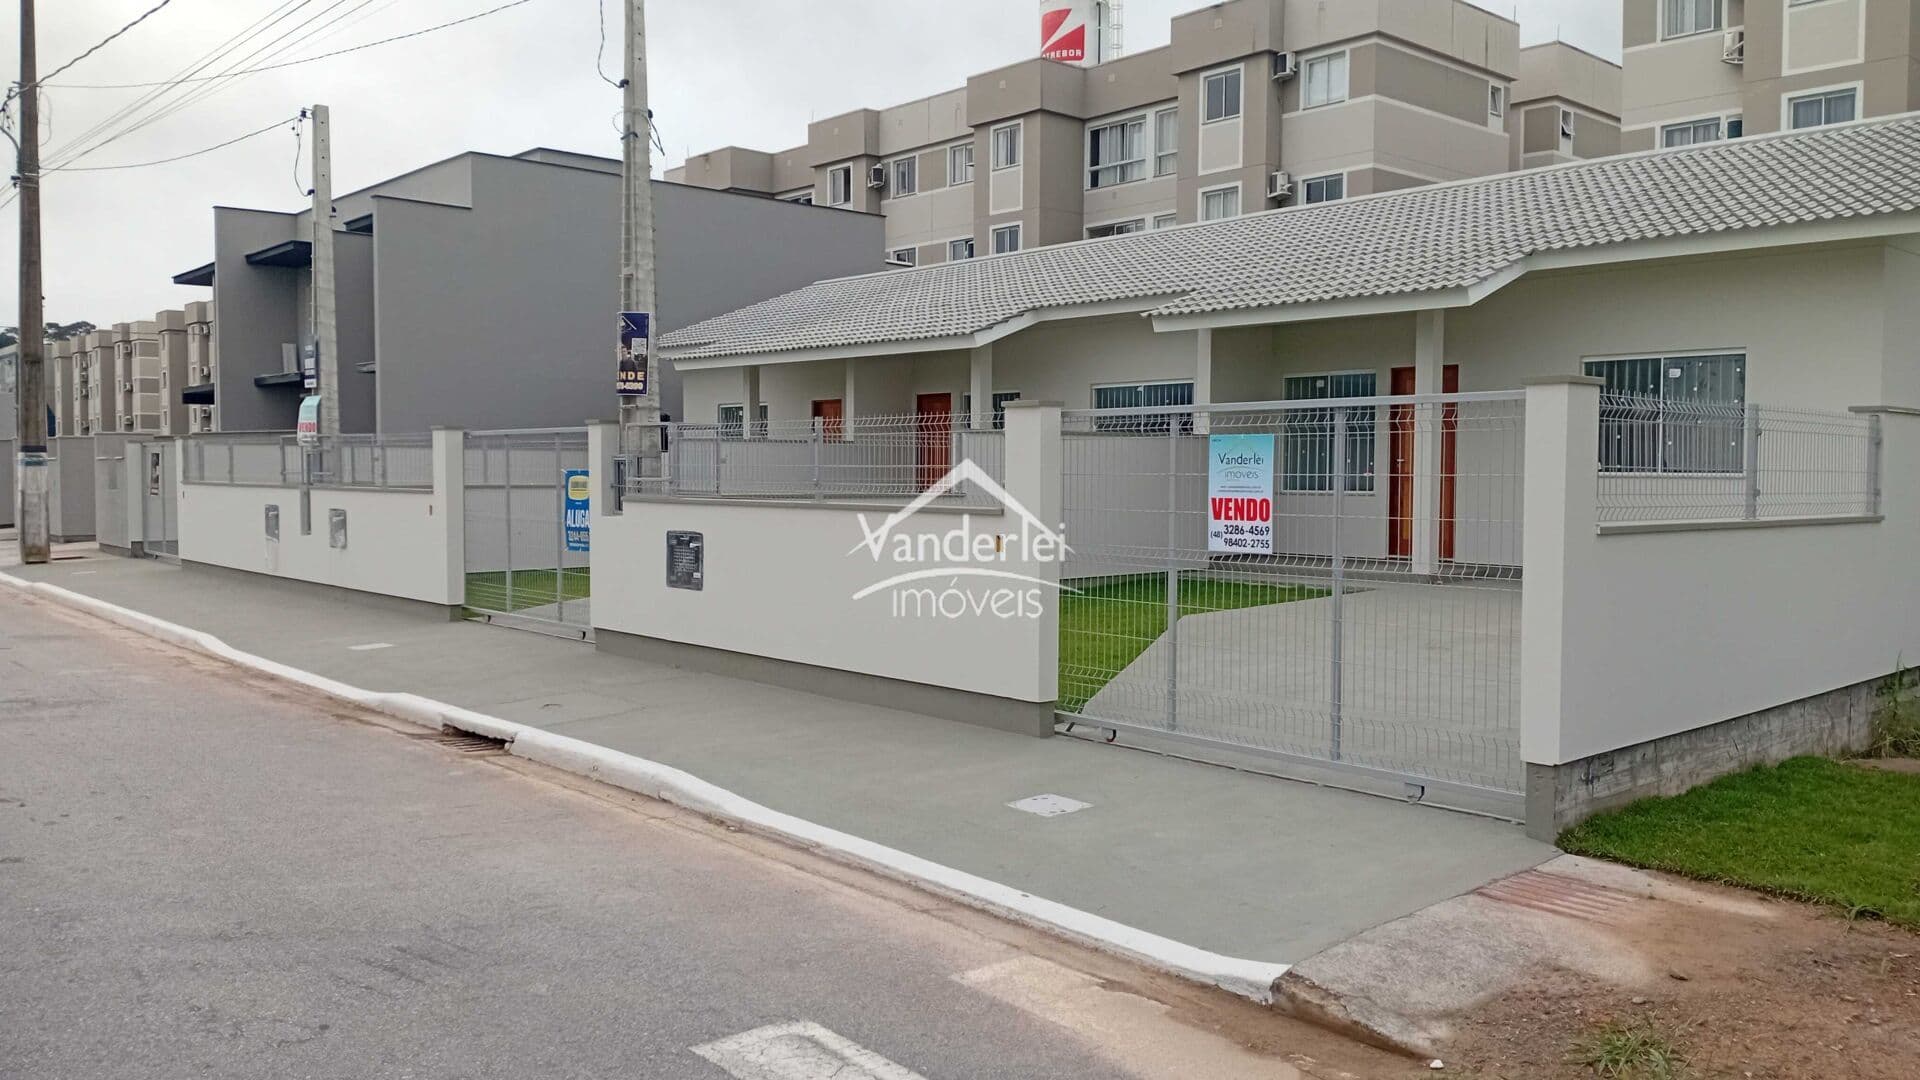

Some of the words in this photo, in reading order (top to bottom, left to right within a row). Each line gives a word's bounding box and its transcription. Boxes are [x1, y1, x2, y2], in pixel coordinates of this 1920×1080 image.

[1218, 452, 1264, 465] Vanderlei
[1211, 497, 1271, 522] VENDO
[1210, 530, 1223, 540] (48)
[1223, 524, 1270, 536] 3286-4569
[1223, 537, 1270, 549] 98402-2755
